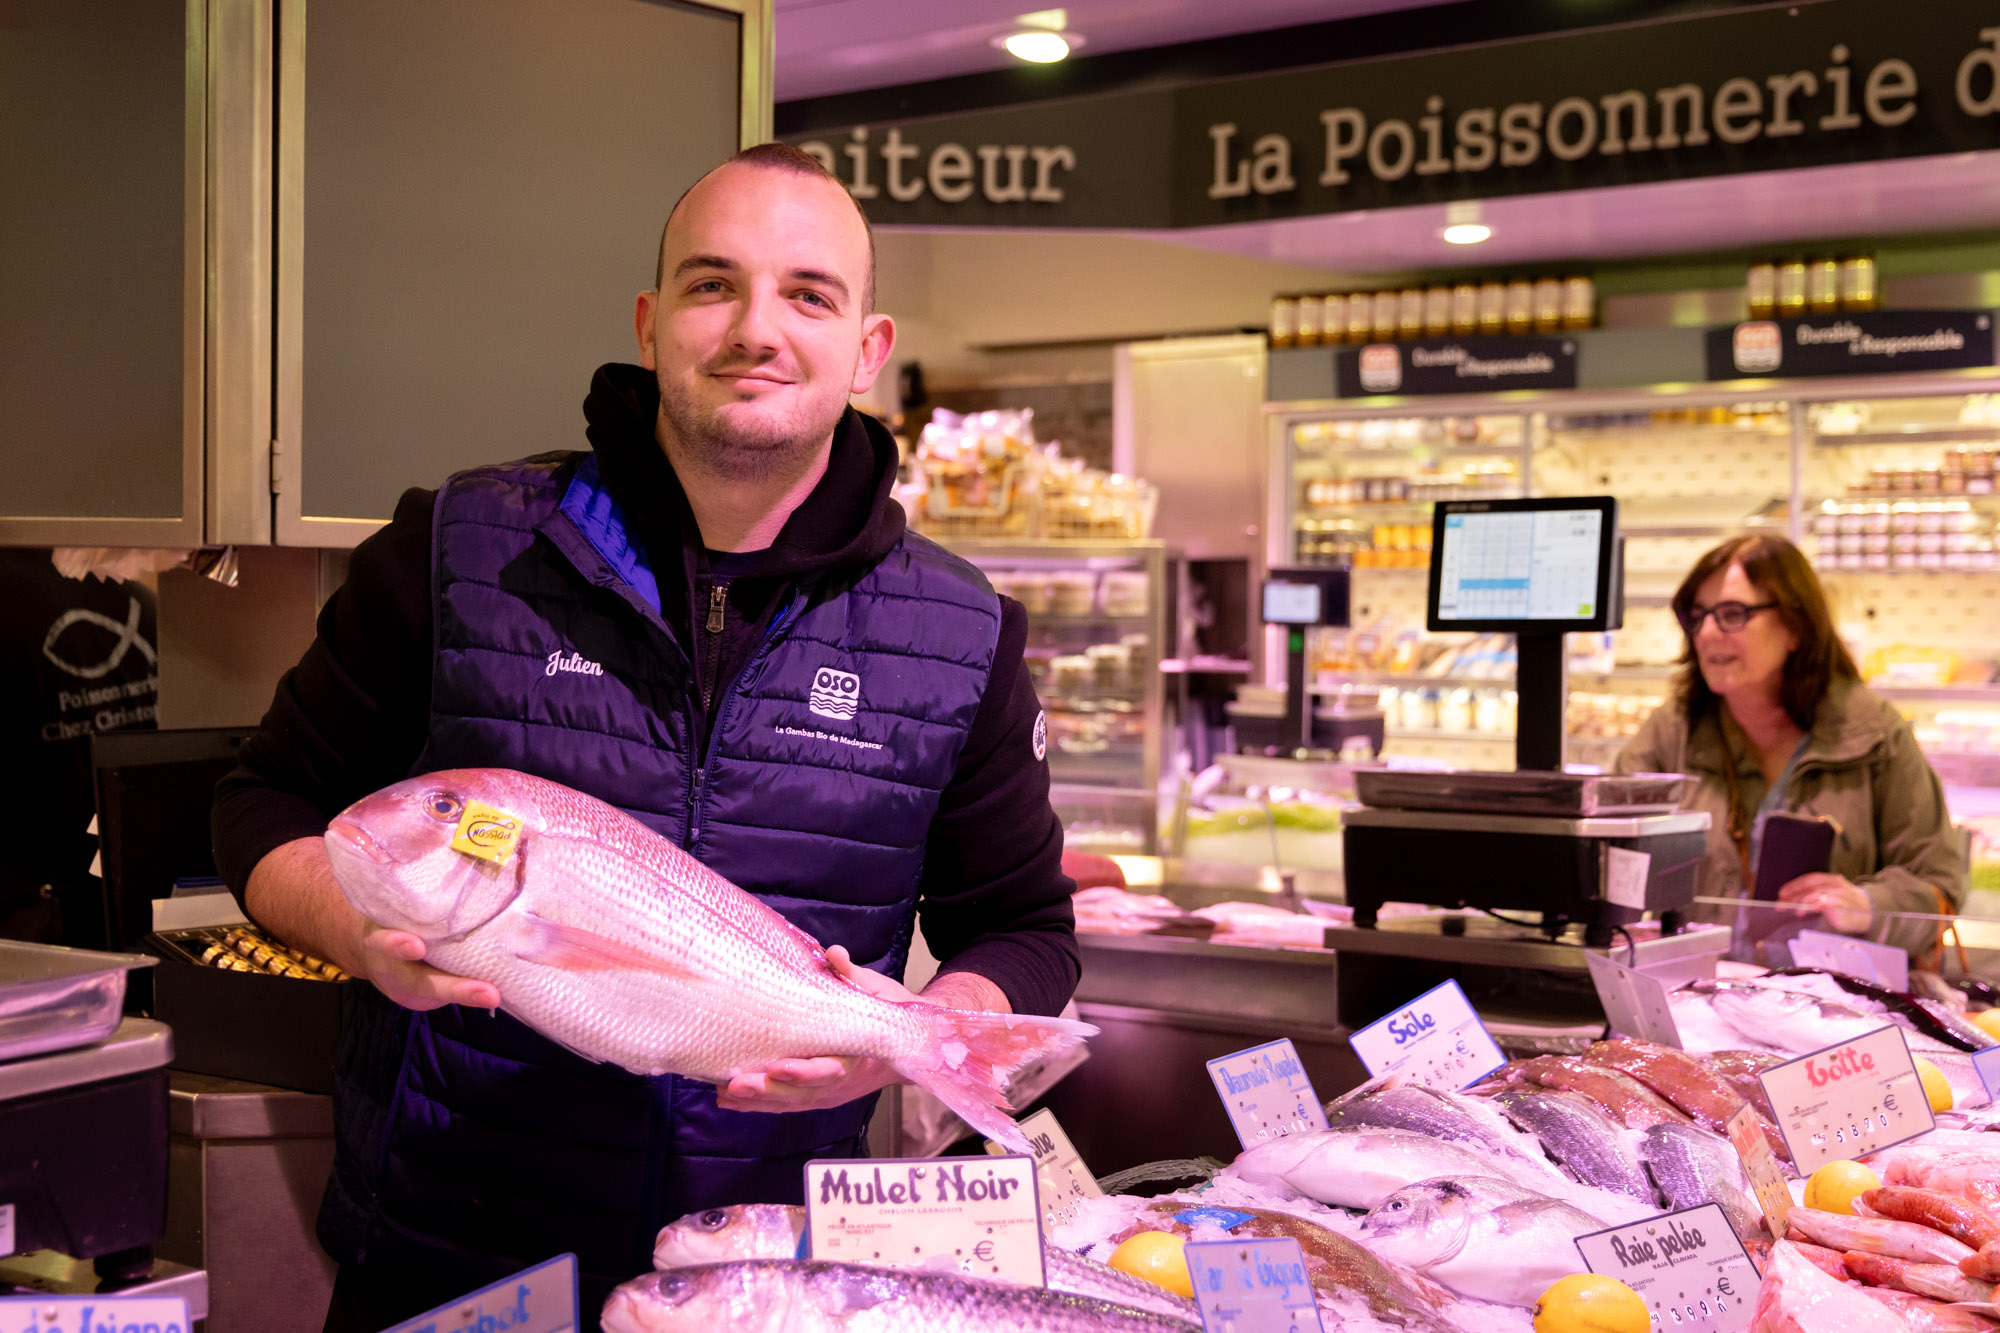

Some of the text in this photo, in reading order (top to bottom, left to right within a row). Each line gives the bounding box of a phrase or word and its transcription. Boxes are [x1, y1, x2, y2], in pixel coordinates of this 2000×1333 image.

[1208, 122, 1297, 199] La
[1319, 43, 1919, 187] Poissonnerie
[545, 650, 603, 676] Julien
[817, 671, 857, 694] OSO
[775, 725, 883, 750] La Gambas Bio de Madagascar
[1388, 1010, 1435, 1044] Sole
[1805, 1047, 1876, 1088] Lotte
[820, 1164, 1019, 1205] Mulet Noir
[1610, 1220, 1707, 1268] Raie pelée
